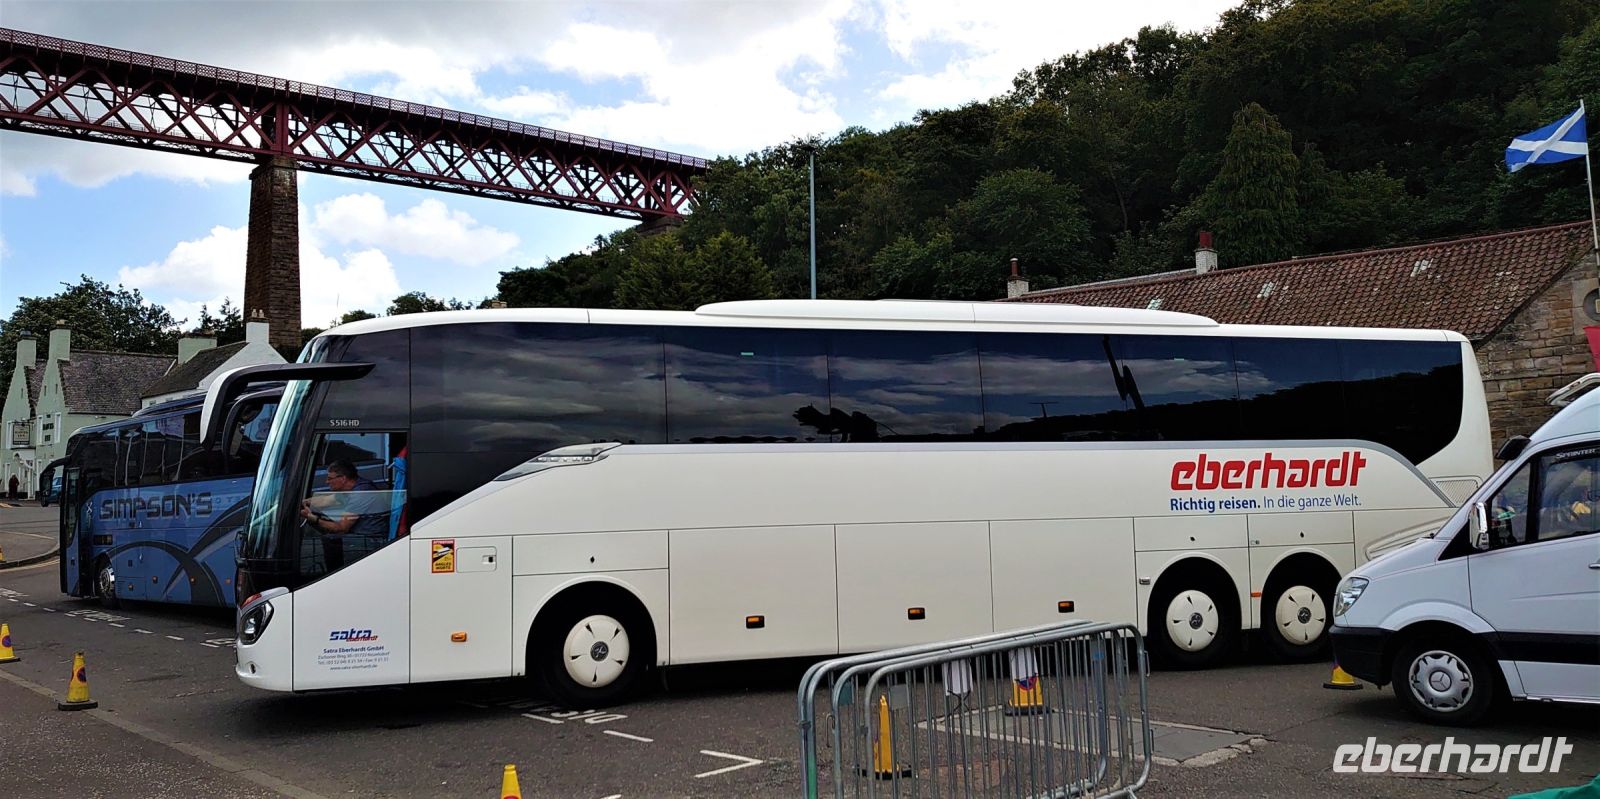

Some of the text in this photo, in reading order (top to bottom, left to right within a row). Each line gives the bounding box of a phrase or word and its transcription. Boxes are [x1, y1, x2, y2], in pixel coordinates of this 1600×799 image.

[330, 419, 360, 427] S 516 HD
[1170, 451, 1367, 491] eberhardt
[98, 492, 213, 520] SIMPSON'S
[1170, 493, 1362, 513] Richtig reisen. In die ganze Welt.
[329, 628, 372, 641] satra
